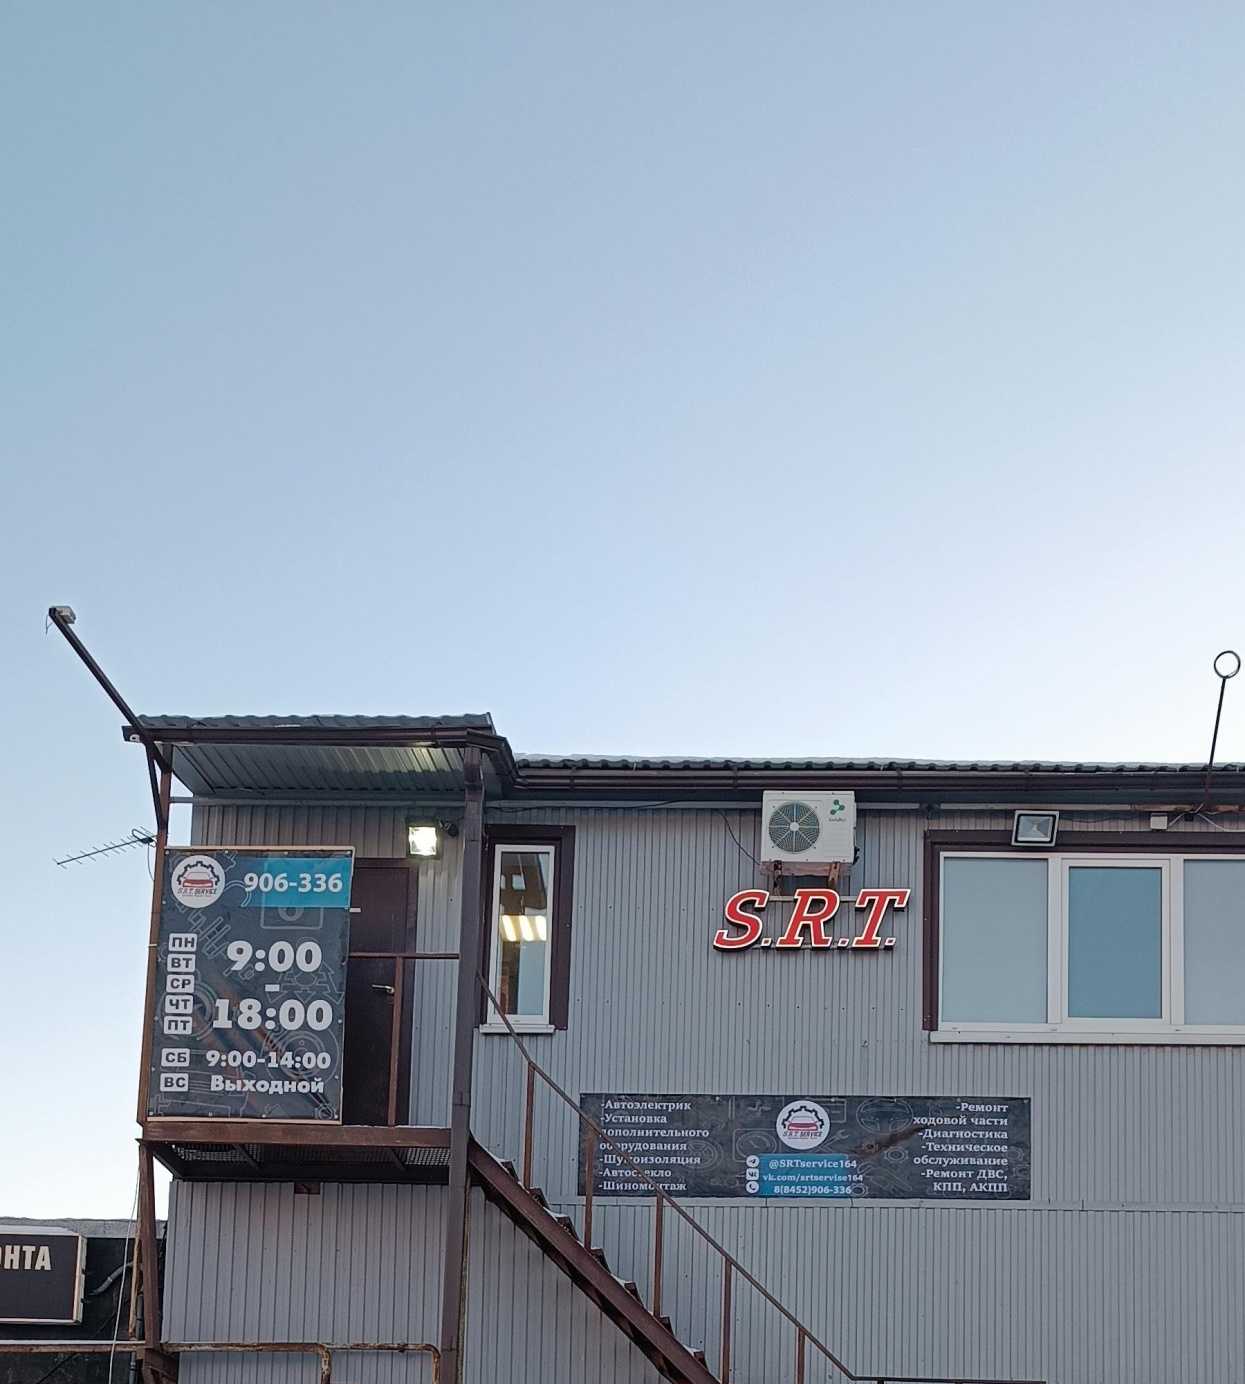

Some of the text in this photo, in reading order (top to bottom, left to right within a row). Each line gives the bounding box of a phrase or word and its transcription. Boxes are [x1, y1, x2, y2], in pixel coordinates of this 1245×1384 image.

[244, 872, 343, 893] 906-336
[713, 888, 911, 950] S.R.T.
[171, 936, 195, 948] ПН
[226, 940, 322, 973] 9:00
[171, 957, 193, 969] ВТ
[170, 977, 192, 990] СР
[168, 999, 190, 1010] ЧТ
[212, 998, 333, 1031] 18:00
[167, 1019, 190, 1031] ПТ
[165, 1051, 188, 1063] СБ
[205, 1050, 332, 1069] 9:00-14:00
[164, 1077, 186, 1089] ВС
[210, 1076, 324, 1093] Выходной
[601, 1100, 692, 1112] -Автоэлектрик
[956, 1102, 1008, 1112] -Ремонт
[601, 1113, 667, 1123] -Установка
[913, 1115, 1008, 1126] ходовой части
[919, 1128, 1008, 1139] -Диагностика
[922, 1142, 1008, 1152] -Техническое
[600, 1154, 701, 1166] -Шуоизоляция
[913, 1155, 1008, 1167] обслуживание
[921, 1169, 1008, 1180] -Ремонт ДВС,
[774, 1186, 852, 1195] 8(8452)906-336
[933, 1182, 1008, 1193] КПП, АКПП
[0, 1245, 51, 1270] НТА
